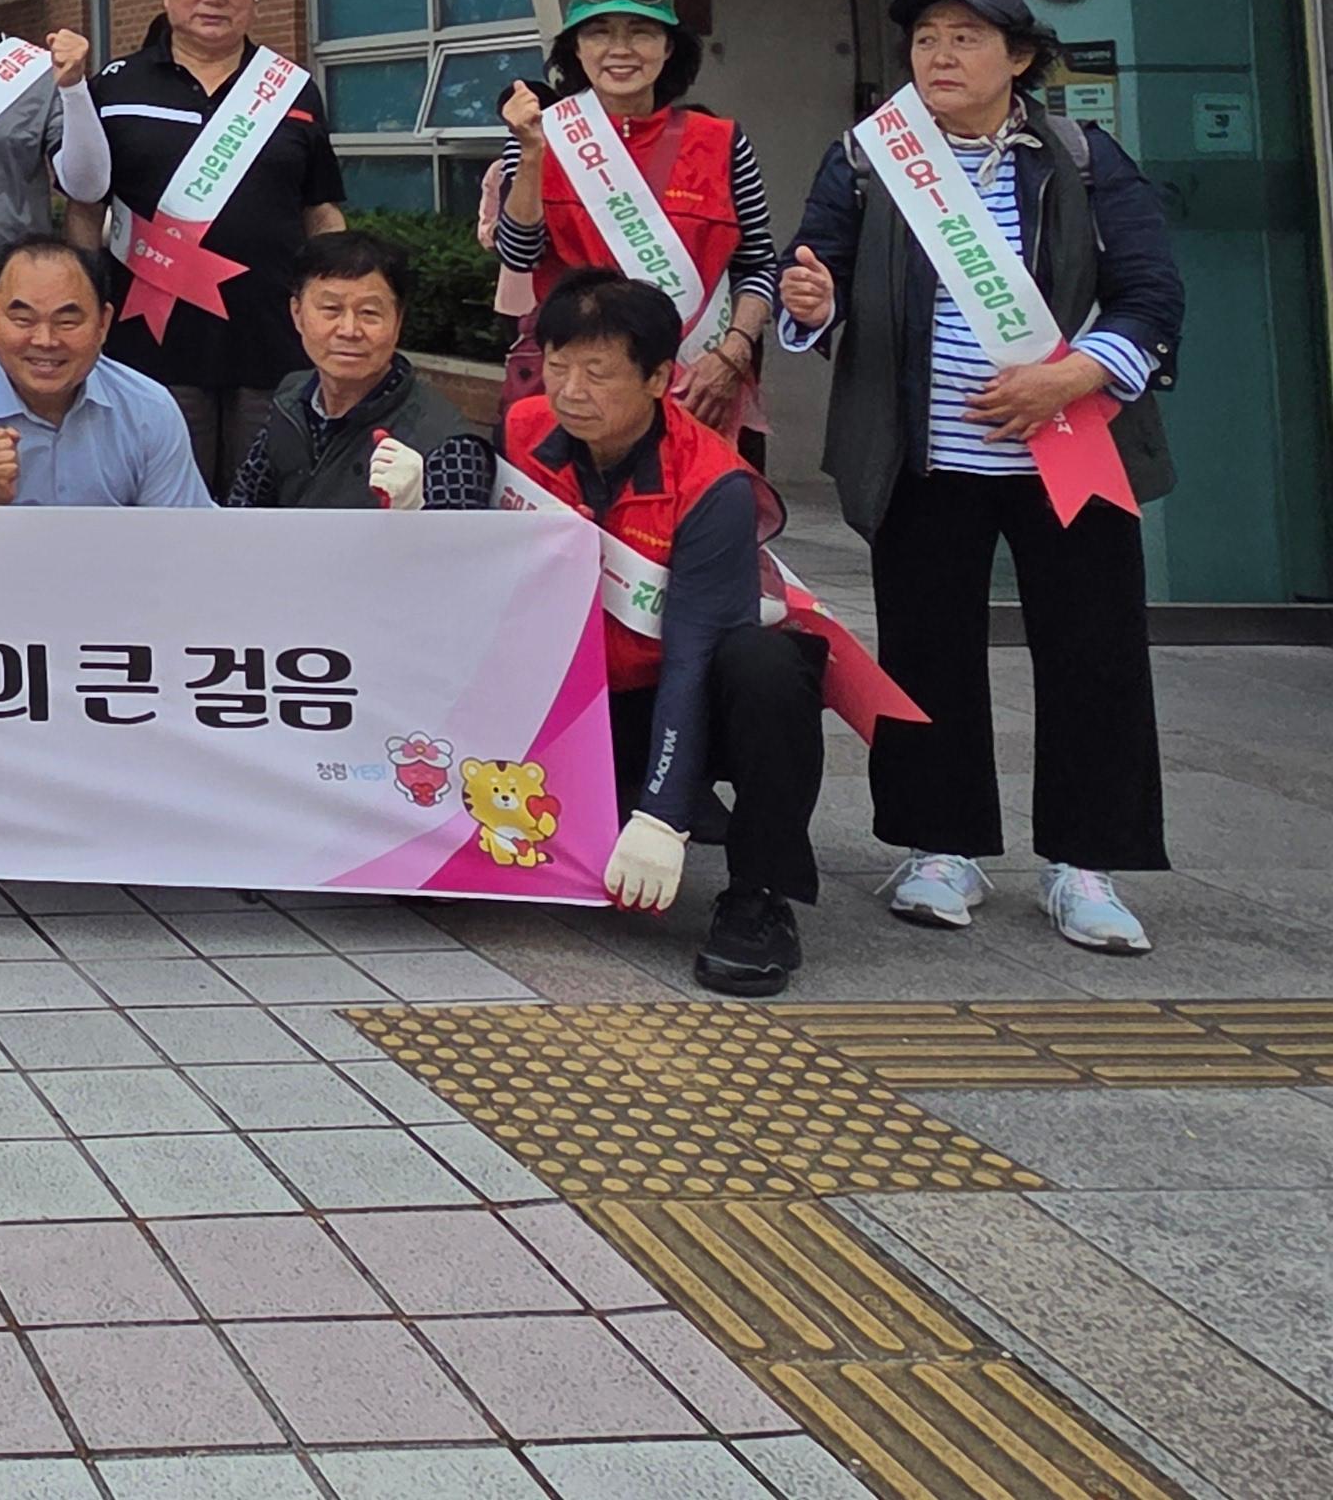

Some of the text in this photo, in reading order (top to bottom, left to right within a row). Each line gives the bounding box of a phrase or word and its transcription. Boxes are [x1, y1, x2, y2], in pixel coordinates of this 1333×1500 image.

[184, 113, 256, 202] 청렴양산
[873, 101, 1033, 343] 께해요! 청렴양산
[77, 646, 160, 725] 큰
[186, 649, 359, 732] 걸음
